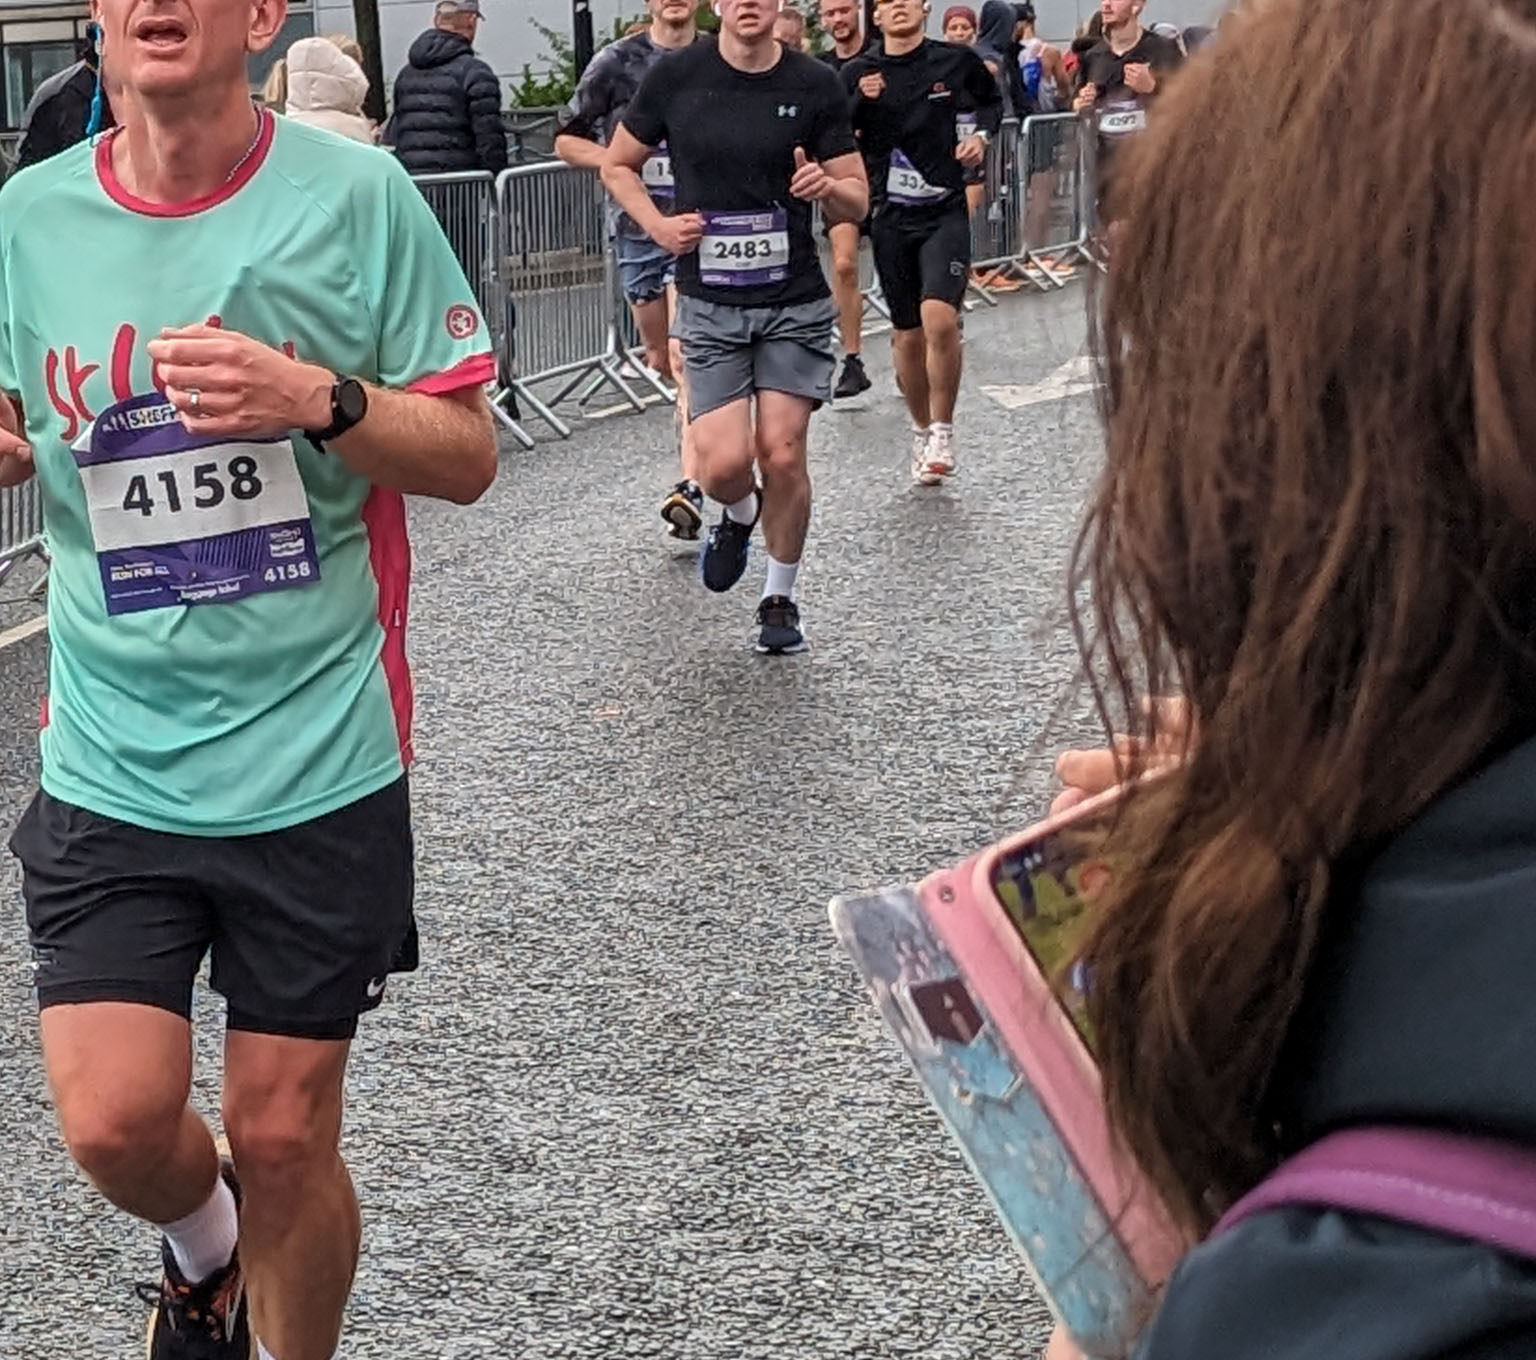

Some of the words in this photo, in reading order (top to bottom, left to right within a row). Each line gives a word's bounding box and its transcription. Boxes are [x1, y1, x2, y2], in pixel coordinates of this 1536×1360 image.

[714, 239, 772, 259] 2483
[129, 405, 177, 427] SHEFF
[122, 455, 263, 517] 4158
[264, 561, 311, 582] 4158
